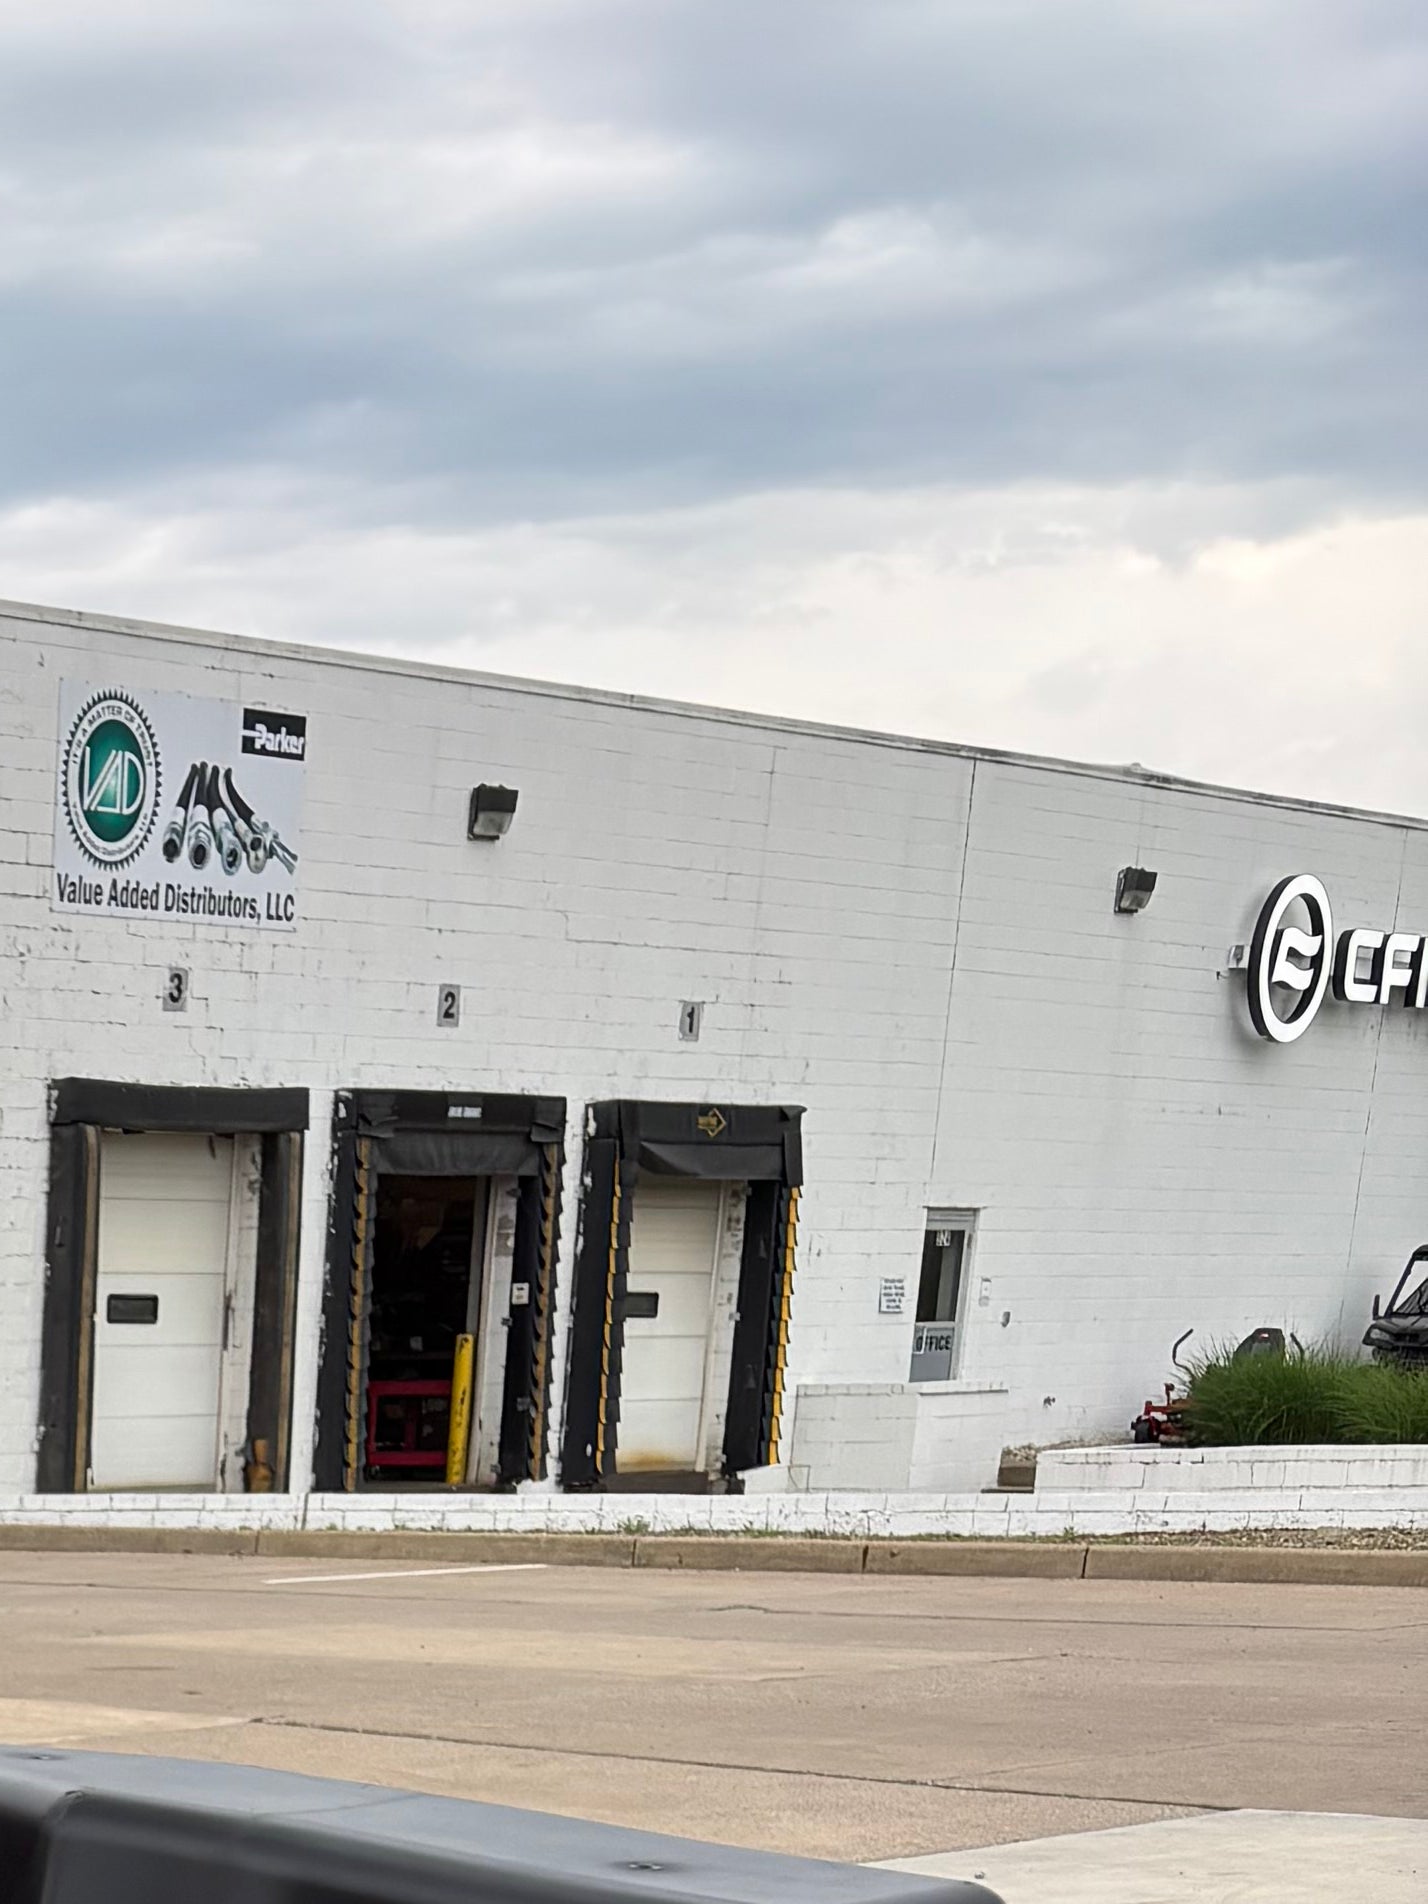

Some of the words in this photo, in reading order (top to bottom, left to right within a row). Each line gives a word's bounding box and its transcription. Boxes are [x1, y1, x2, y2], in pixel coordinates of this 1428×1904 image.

[254, 723, 305, 755] Parker
[56, 872, 103, 906] Value
[107, 878, 160, 911] Added
[164, 883, 261, 922] Distributors,
[266, 892, 295, 922] LLC
[169, 973, 182, 1003] 3
[443, 991, 456, 1018] 2
[687, 1007, 694, 1033] 1
